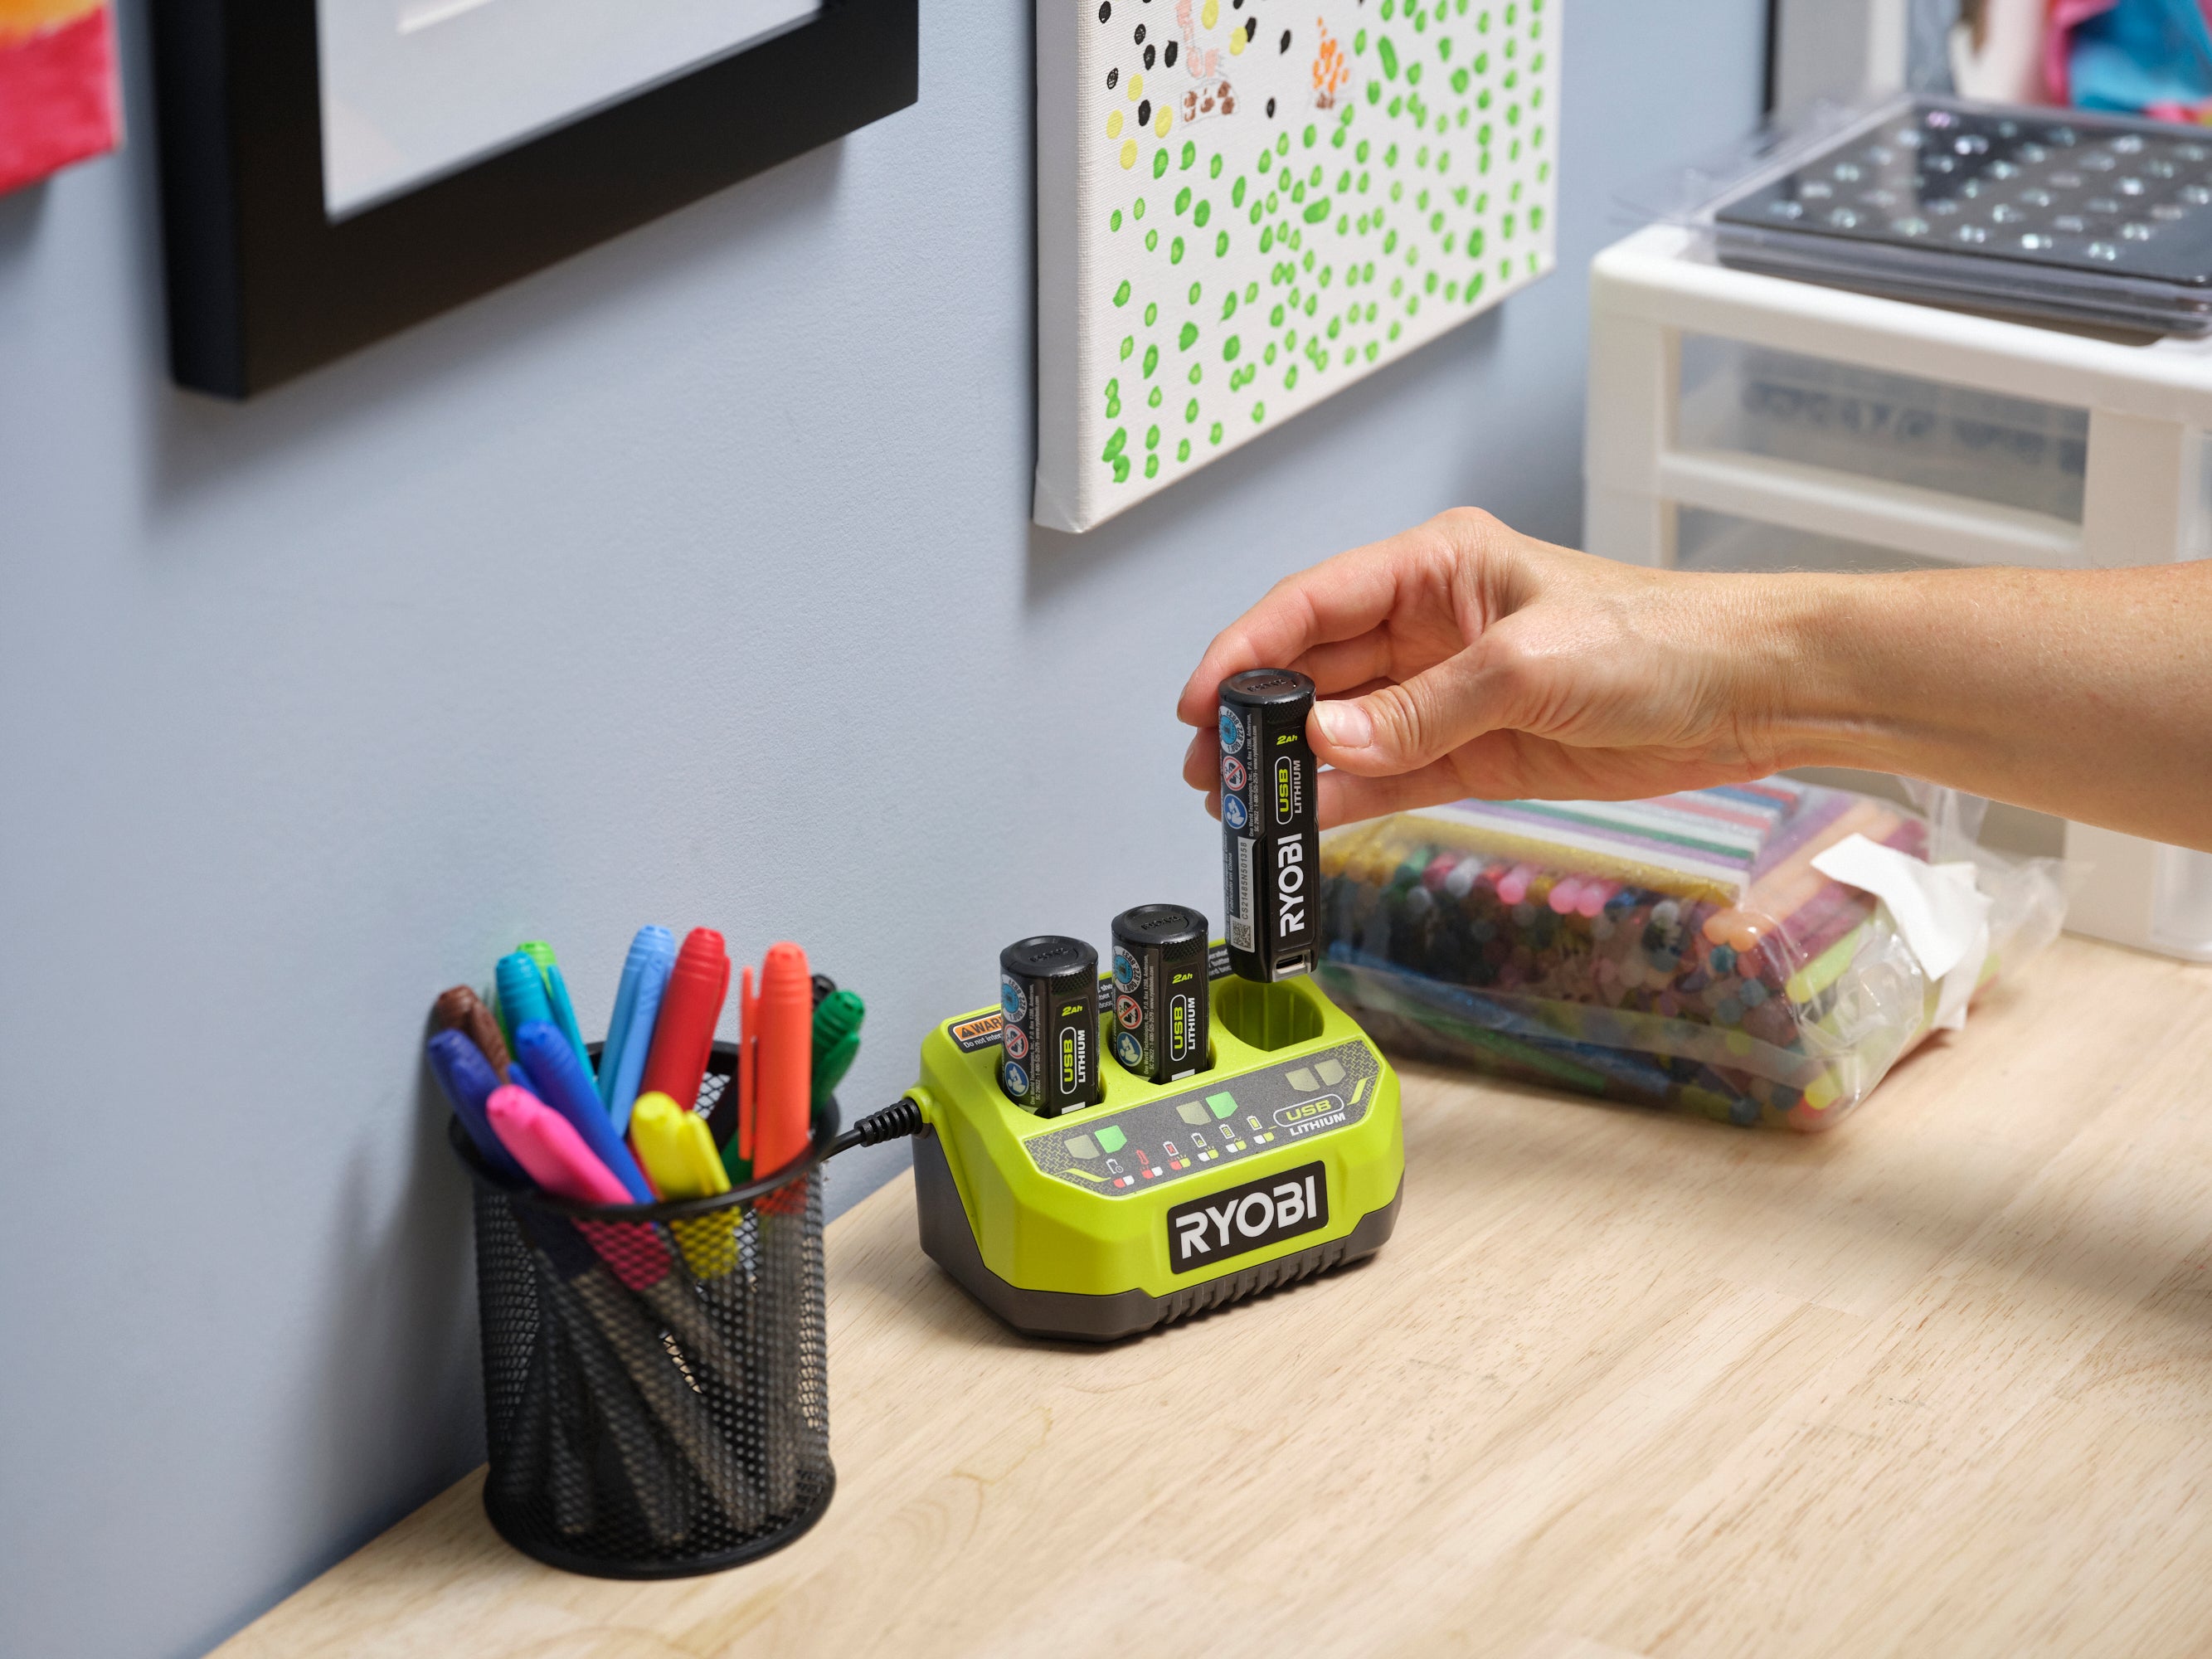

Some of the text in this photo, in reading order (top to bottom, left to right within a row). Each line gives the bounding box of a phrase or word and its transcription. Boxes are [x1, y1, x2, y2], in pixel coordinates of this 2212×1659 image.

[1276, 734, 1298, 746] 2Ah
[1278, 768, 1290, 813] USB
[1293, 760, 1302, 814] LITHIUM
[1240, 842, 1248, 920] CS21485N501358
[1277, 833, 1305, 937] RYOBI
[1172, 973, 1194, 985] 2Ah
[1062, 1005, 1083, 1016] 2Ah
[1174, 1006, 1184, 1049] USB
[1188, 997, 1196, 1050] LITHIUM
[974, 1037, 987, 1045] not
[1063, 1039, 1074, 1082] USB
[1077, 1029, 1087, 1083] LITHIUM
[1286, 1099, 1332, 1121] USB
[1289, 1112, 1346, 1136] LITHIUM
[1175, 1175, 1317, 1259] RYOBI
